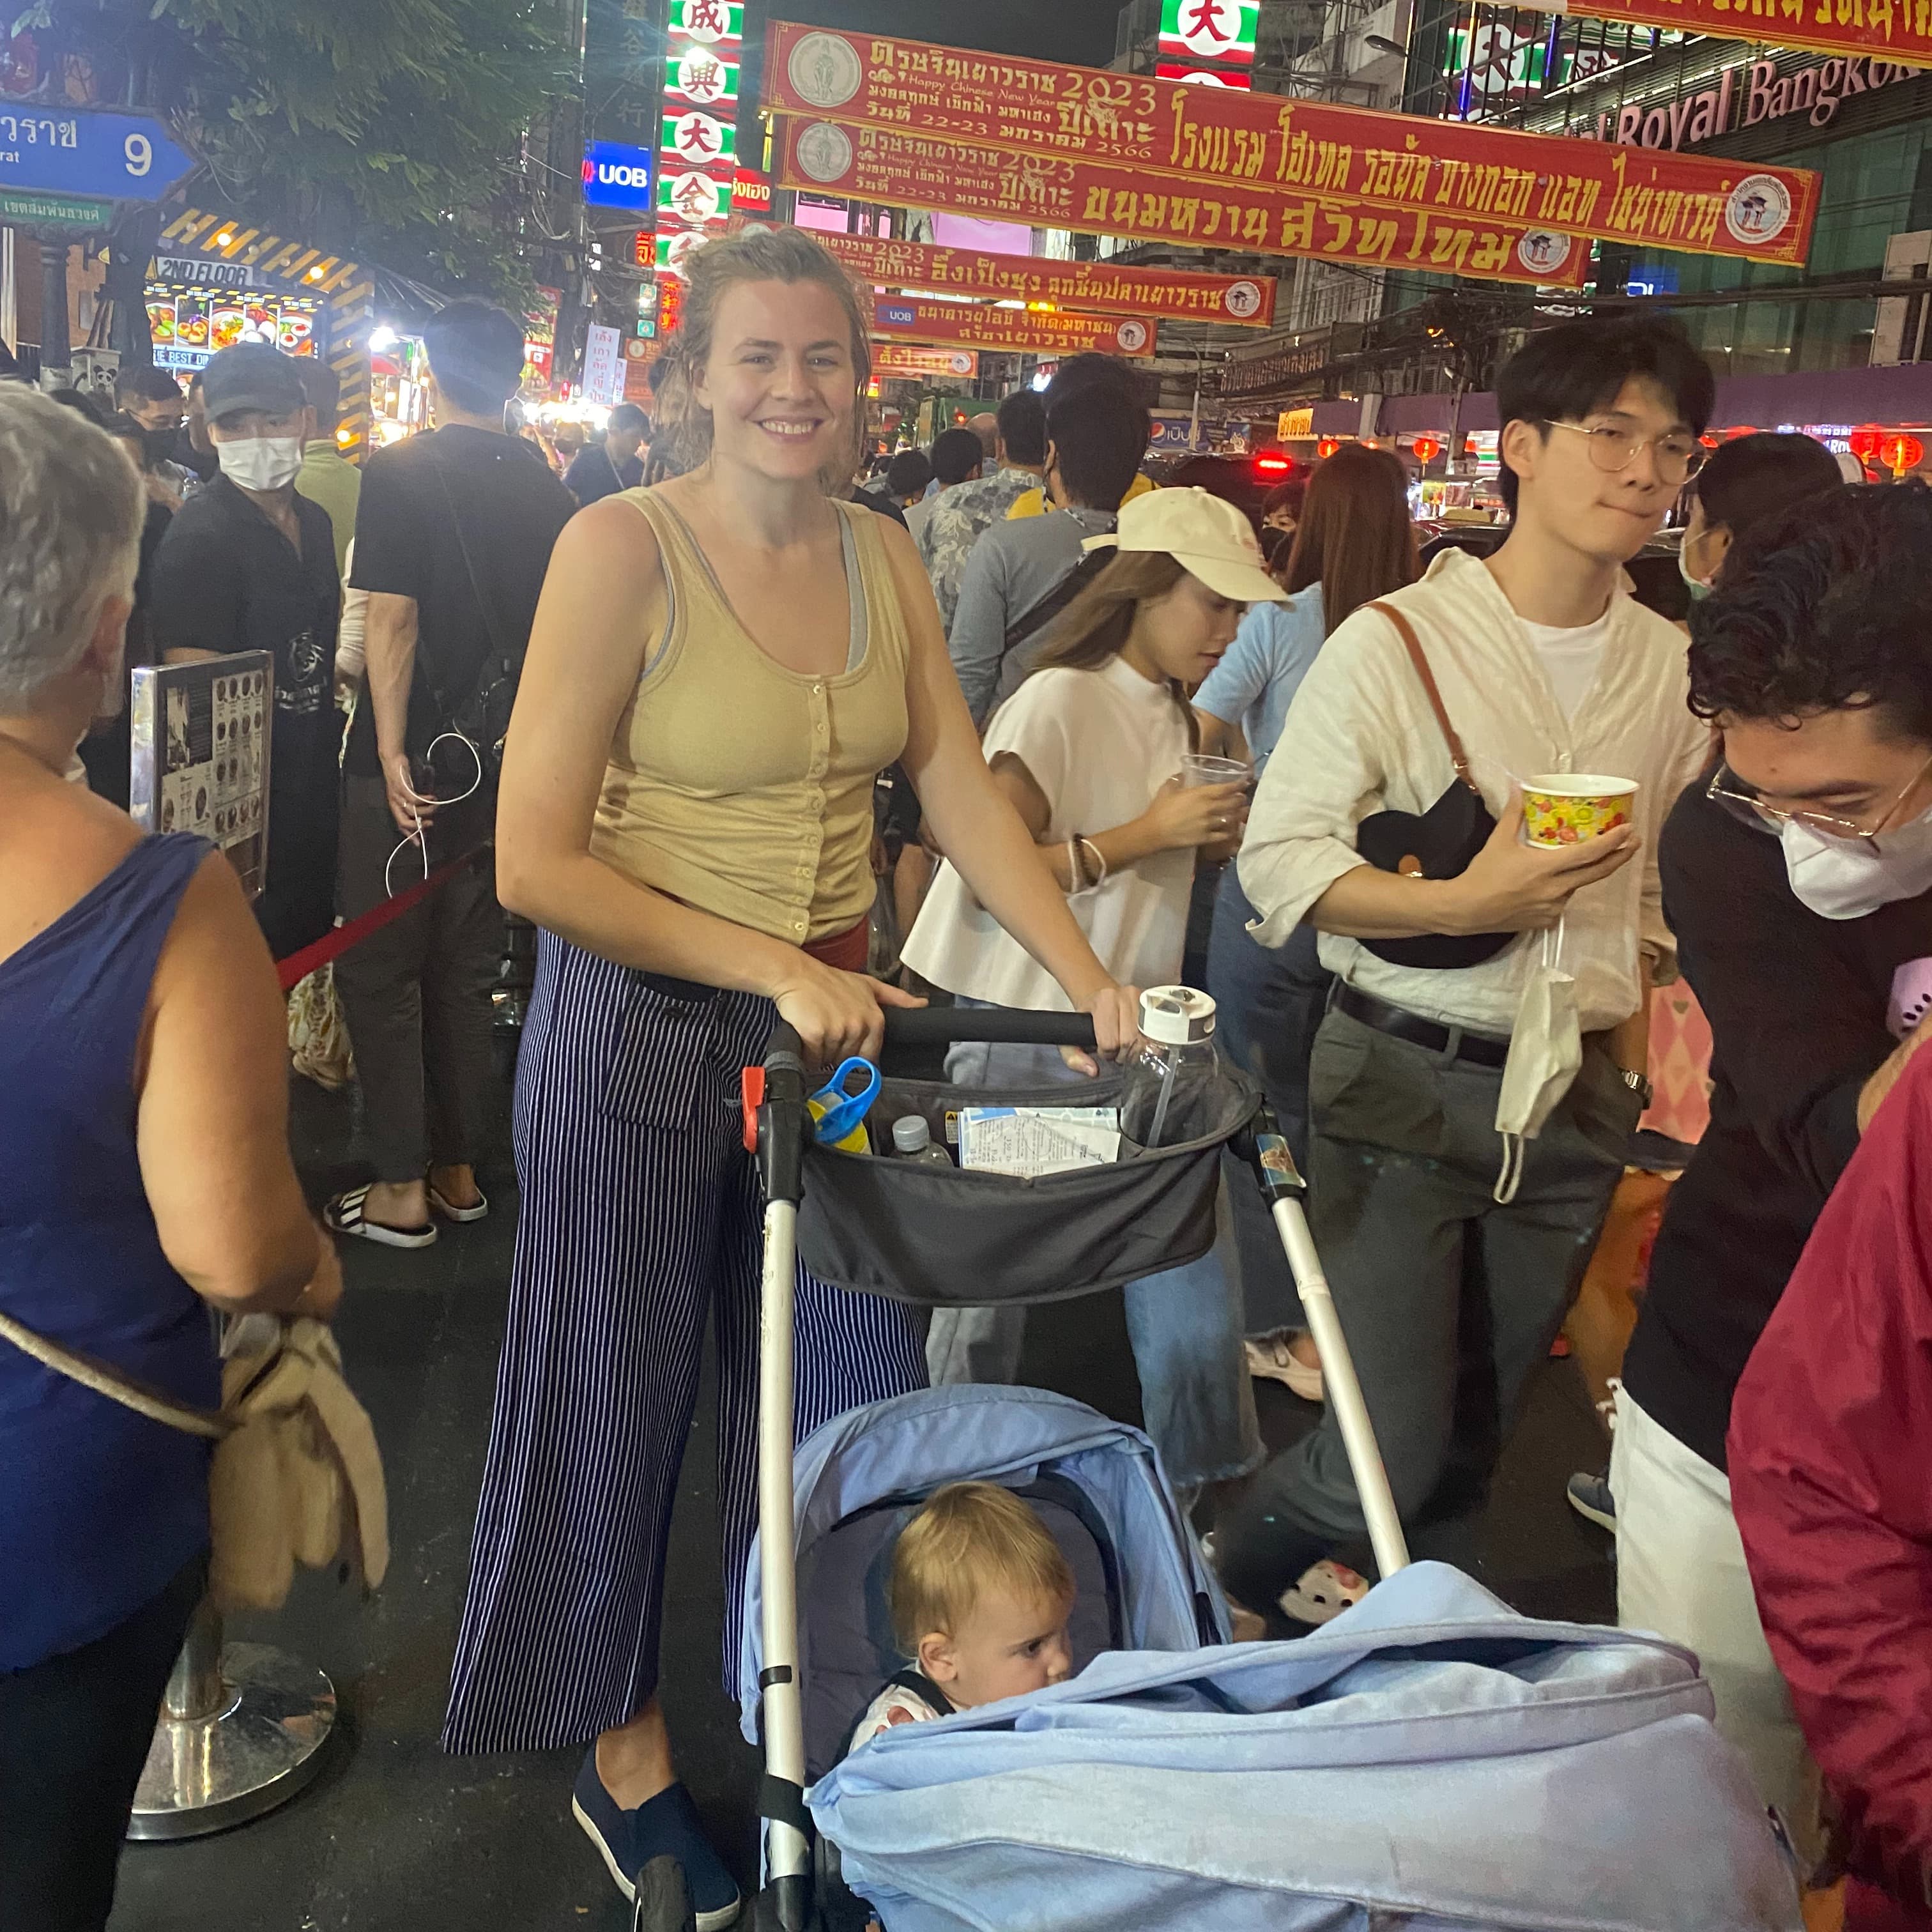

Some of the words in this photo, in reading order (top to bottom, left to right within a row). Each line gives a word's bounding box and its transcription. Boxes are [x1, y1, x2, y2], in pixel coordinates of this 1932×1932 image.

[908, 75, 946, 91] Happy
[951, 81, 993, 98] Chinese
[997, 88, 1024, 102] New
[1029, 93, 1056, 107] Year
[1061, 72, 1156, 116] 2023
[1615, 68, 1733, 152] Royal
[921, 114, 988, 135] 22-23
[1096, 142, 1152, 159] 2566
[1170, 88, 1266, 180] โรงแรม
[125, 134, 152, 176] 9
[1003, 151, 1076, 183] 2023
[599, 164, 648, 187] UOB
[1027, 204, 1071, 218] 2566
[875, 241, 924, 263] 2023
[164, 259, 194, 280] 2ND
[197, 262, 247, 285] FLOOR
[889, 310, 912, 322] UOB
[169, 351, 193, 365] BEST
